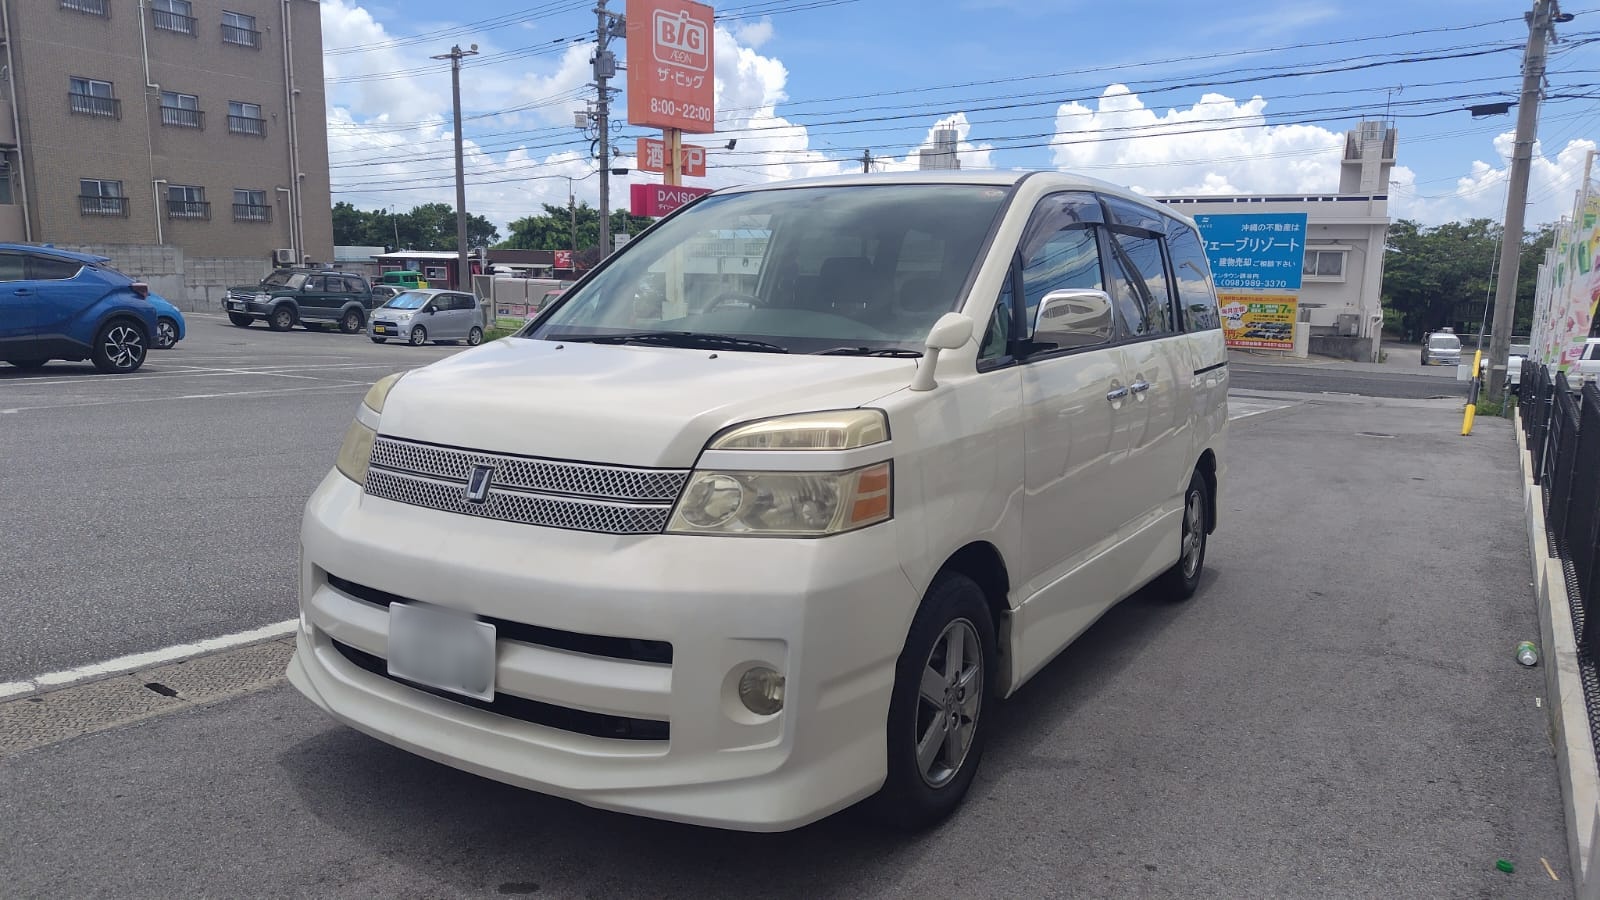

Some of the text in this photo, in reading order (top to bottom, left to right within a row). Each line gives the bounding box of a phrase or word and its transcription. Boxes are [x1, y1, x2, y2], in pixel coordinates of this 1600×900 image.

[662, 15, 700, 49] BIG
[657, 67, 704, 89] ザ・ビッグ
[646, 142, 702, 173] 酒 P
[1241, 223, 1300, 232] 沖縄の不動産は
